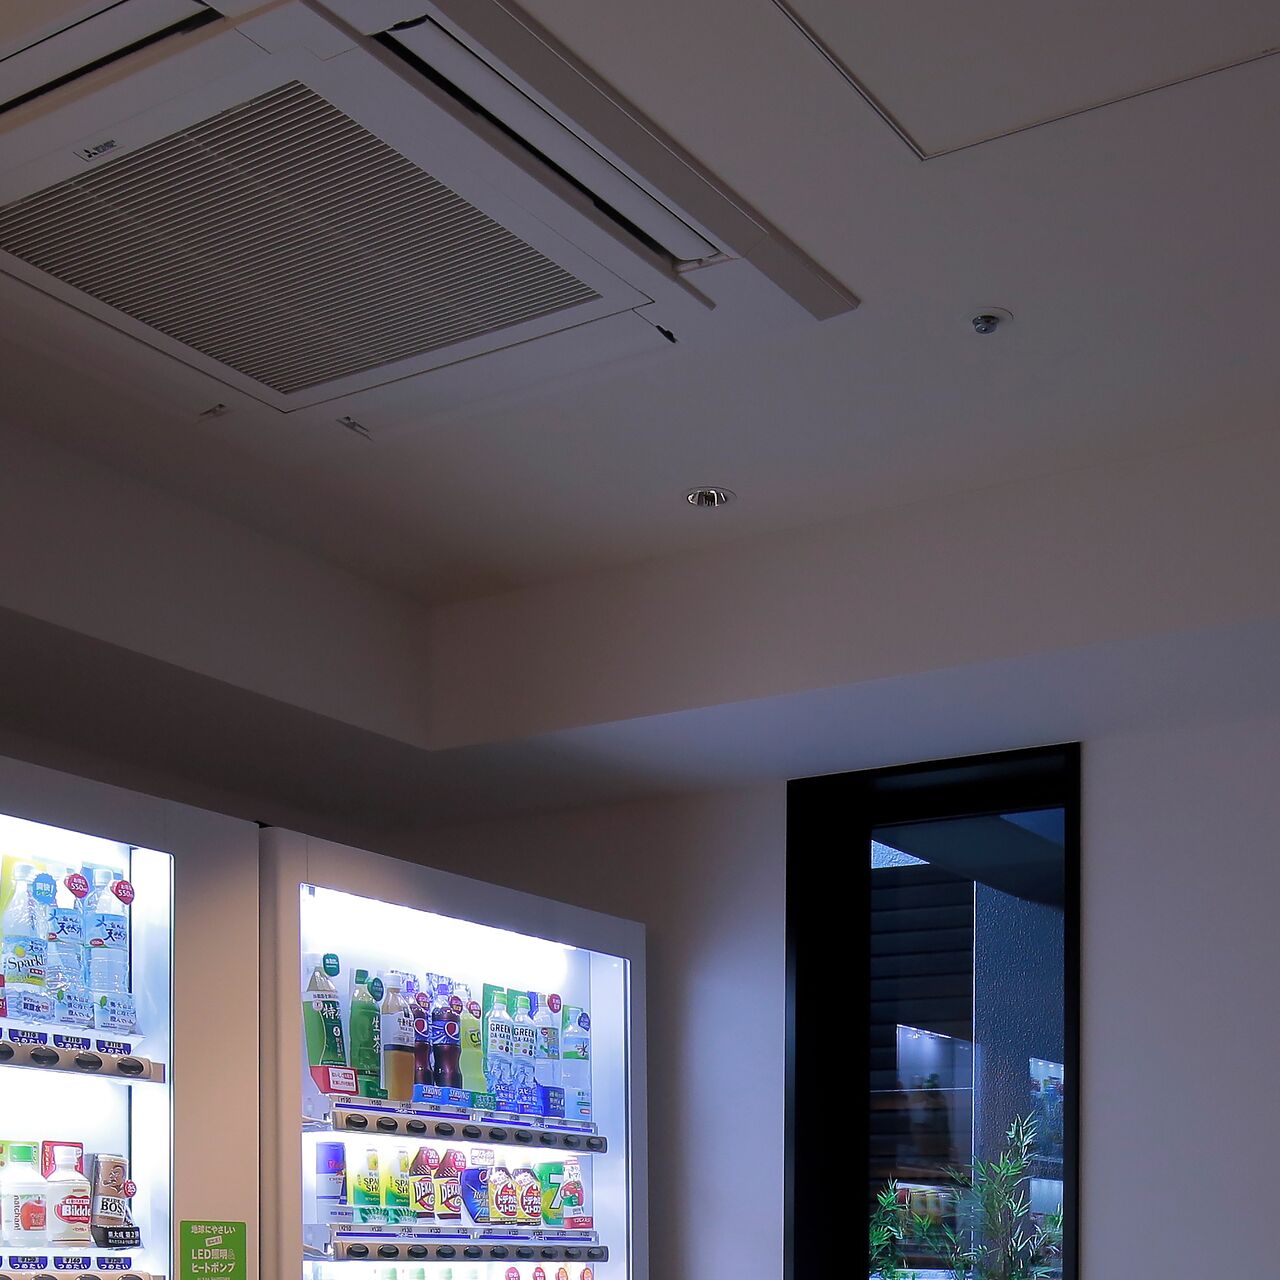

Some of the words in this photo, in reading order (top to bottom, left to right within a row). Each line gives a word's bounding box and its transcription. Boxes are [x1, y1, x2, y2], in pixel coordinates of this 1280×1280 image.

[490, 1022, 511, 1034] GREEN
[514, 1027, 534, 1038] GREEN
[549, 1173, 564, 1210] 7
[13, 1195, 21, 1231] natchan!
[191, 1225, 236, 1235] 地球にやさしい
[191, 1261, 236, 1273] ヒートポンプ
